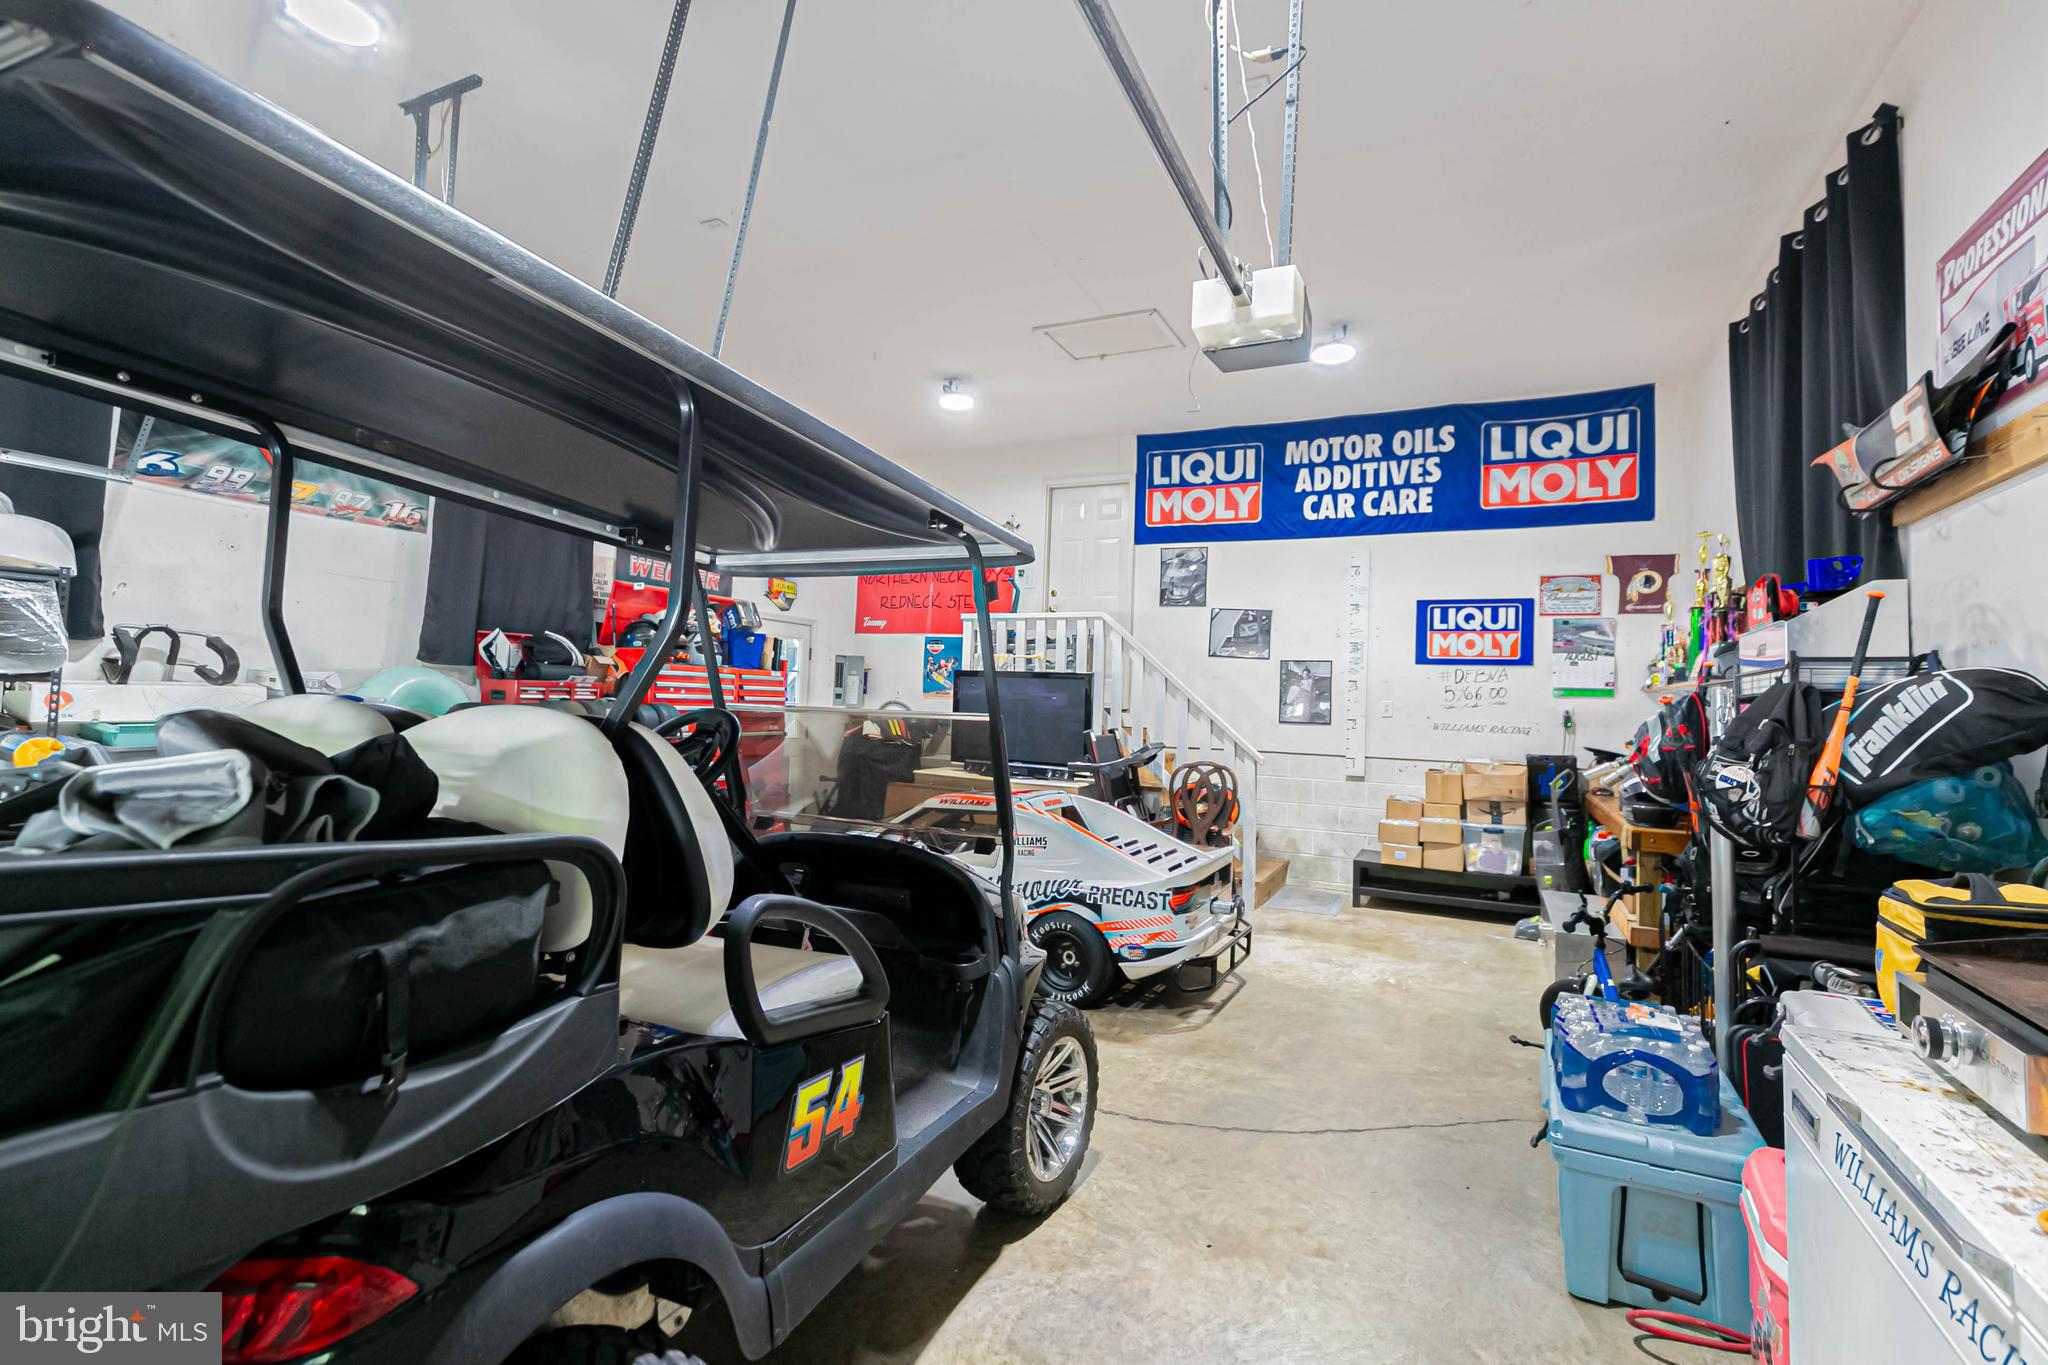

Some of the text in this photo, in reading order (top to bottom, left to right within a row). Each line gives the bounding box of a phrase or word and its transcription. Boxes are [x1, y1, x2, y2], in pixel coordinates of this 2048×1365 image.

[1890, 384, 1929, 457] 5
[1284, 425, 1456, 466] MOTOR OILS
[1490, 413, 1630, 461] LIQUI
[204, 464, 256, 490] 99
[1152, 448, 1256, 485] LIQUI
[1294, 456, 1442, 493] ADDITIVES
[1489, 457, 1635, 504] MOLY
[383, 502, 425, 525] 16
[1152, 485, 1260, 522] MOLY
[1303, 486, 1433, 521] CAR CARE
[984, 568, 1012, 585] OYS
[880, 592, 974, 611] REDNECK STE
[1433, 607, 1516, 631] LIQUI
[1432, 633, 1519, 657] MOLY
[1432, 722, 1533, 736] WILLIAMS RACING
[939, 798, 994, 807] WILLIAMS
[1014, 836, 1048, 846] LLIAMS
[1017, 849, 1035, 857] RACING
[1086, 885, 1172, 912] PRECAST
[784, 1054, 866, 1172] 54
[1834, 1131, 2029, 1365] WILLIAMS RACI
